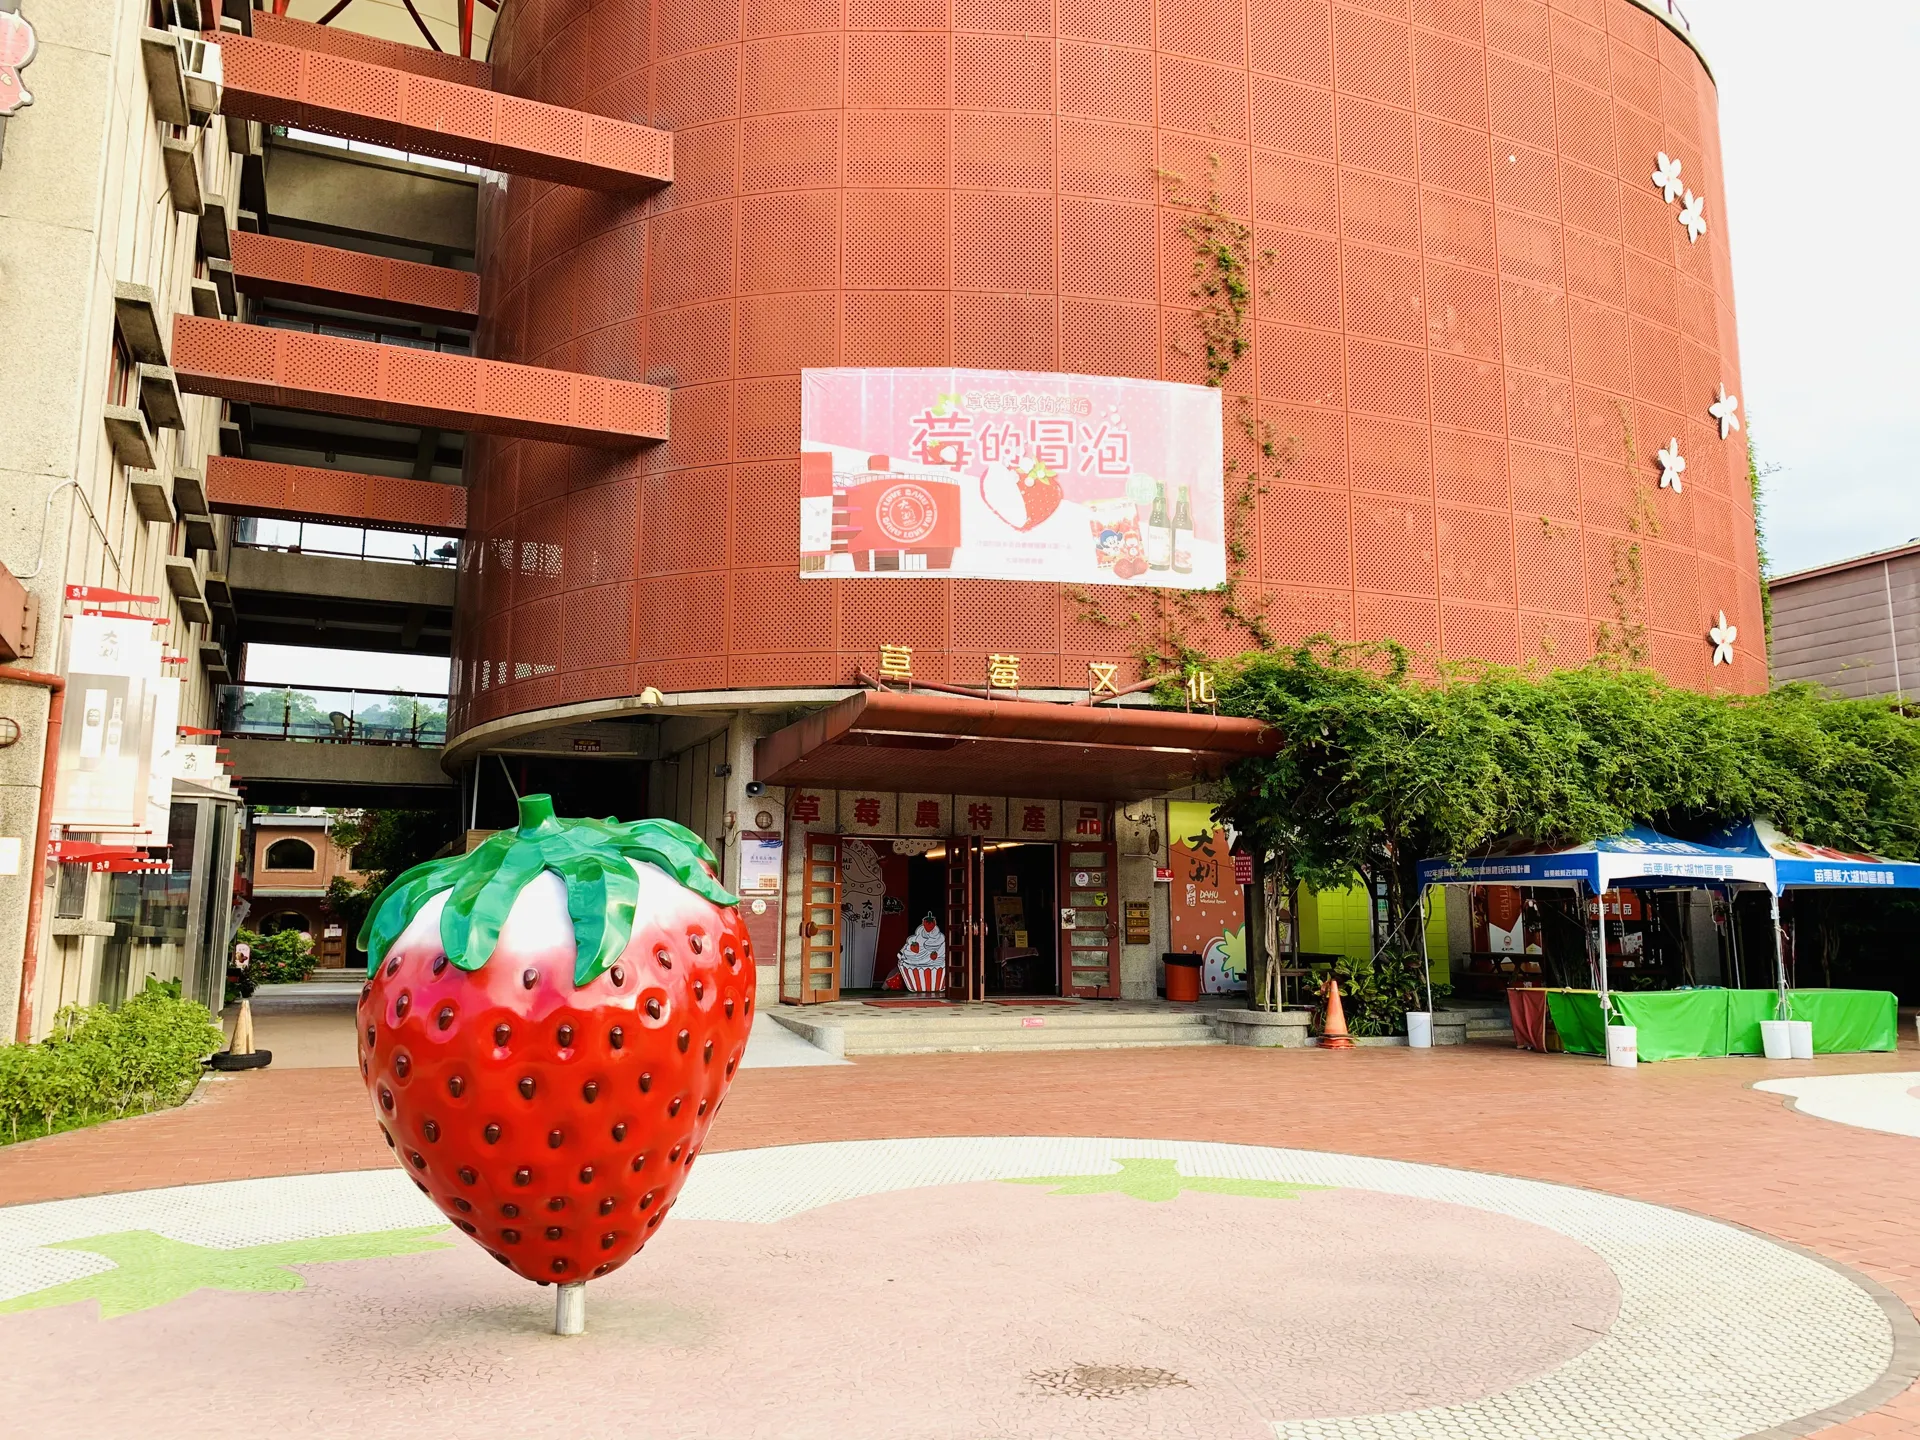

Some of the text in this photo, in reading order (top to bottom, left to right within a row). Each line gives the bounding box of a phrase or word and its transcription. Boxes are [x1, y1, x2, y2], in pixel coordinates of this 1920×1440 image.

[911, 410, 1131, 475] 莓的冒泡
[883, 489, 902, 507] LOVE
[904, 526, 925, 538] LOVE
[879, 645, 1217, 704] 草莓文化
[792, 794, 1102, 836] 草莓農特產品
[1188, 828, 1218, 888] 大湖
[1643, 862, 1734, 877] 苗栗縣大湖地區農會
[1814, 868, 1895, 885] 苗栗縣大湖地區農會
[1200, 889, 1218, 899] DAHU
